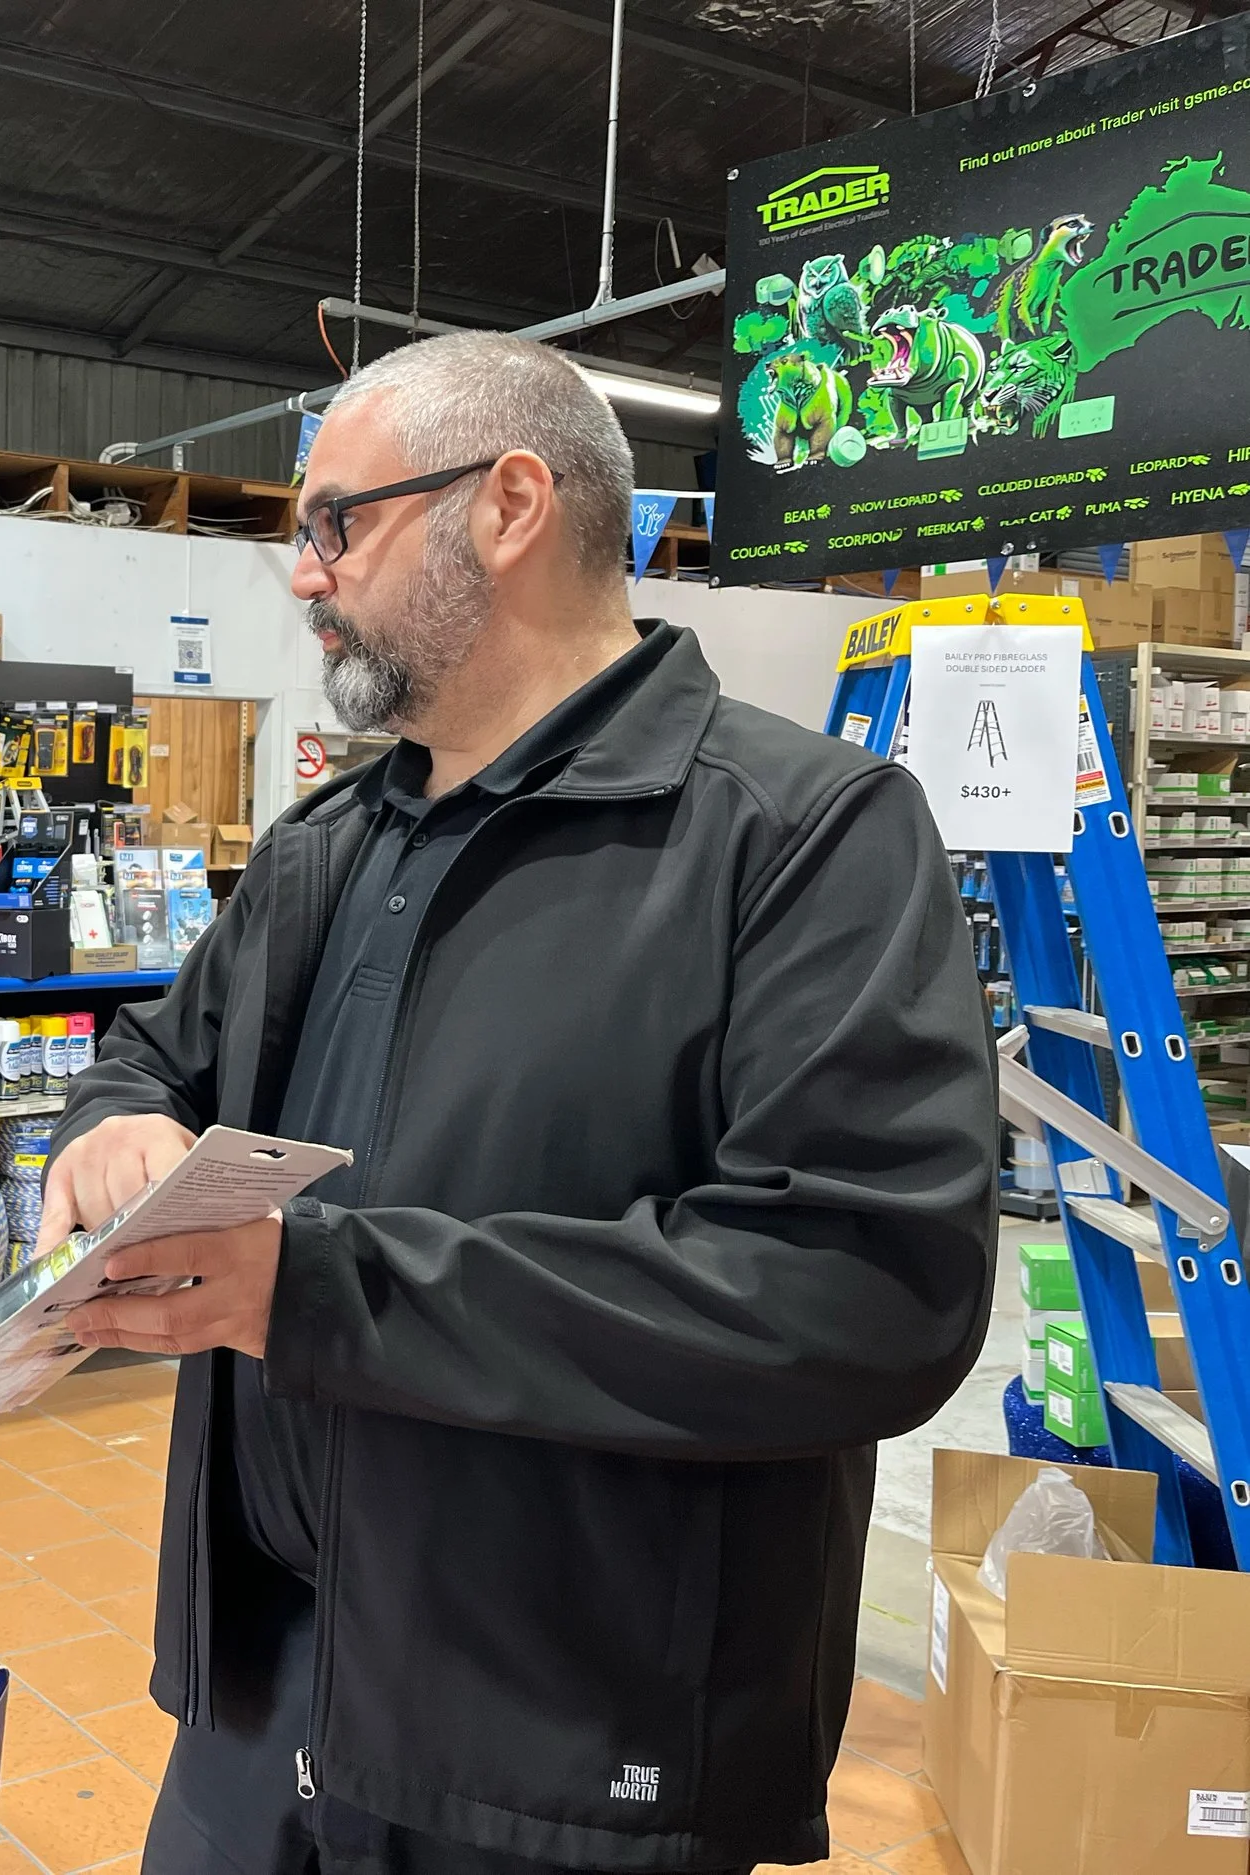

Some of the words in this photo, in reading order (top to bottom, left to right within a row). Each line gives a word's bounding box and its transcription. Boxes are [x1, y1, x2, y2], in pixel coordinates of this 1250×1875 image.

[959, 152, 988, 172] Find
[992, 146, 1014, 163] out
[1018, 138, 1053, 156] more
[1056, 121, 1096, 145] about
[1100, 107, 1146, 131] Trader
[1149, 97, 1180, 117] visit
[1184, 76, 1250, 110] gsme.co
[757, 172, 890, 225] TRADER
[771, 232, 790, 244] Years
[790, 229, 799, 239] of
[824, 215, 855, 231] Electrical
[857, 208, 890, 222] Tradition
[1093, 234, 1250, 295] TRADE
[1130, 456, 1188, 475] LEOPARD
[977, 478, 1032, 497] CLOUDED
[1034, 471, 1085, 489] LEOPARD
[850, 500, 885, 515] SNOW
[887, 492, 938, 510] LEOPARD
[1170, 486, 1226, 505] HYENA
[783, 508, 816, 525] BEAR
[1029, 509, 1054, 524] CAT
[1085, 501, 1122, 516] PUMA
[917, 519, 971, 538] MEERKAT
[827, 531, 893, 550] SCORPION
[730, 543, 782, 561] COUGAR
[845, 613, 902, 660] BAILEY
[945, 652, 973, 661] BAILEY
[974, 653, 992, 661] PRO
[993, 652, 1048, 662] FIBREGLASS
[945, 665, 979, 673] DOUBLE
[981, 665, 1008, 673] SIDED
[1009, 665, 1046, 673] LADDER
[960, 785, 1012, 799] $430+
[622, 1764, 661, 1785] TRUE
[610, 1780, 658, 1802] NORTH
